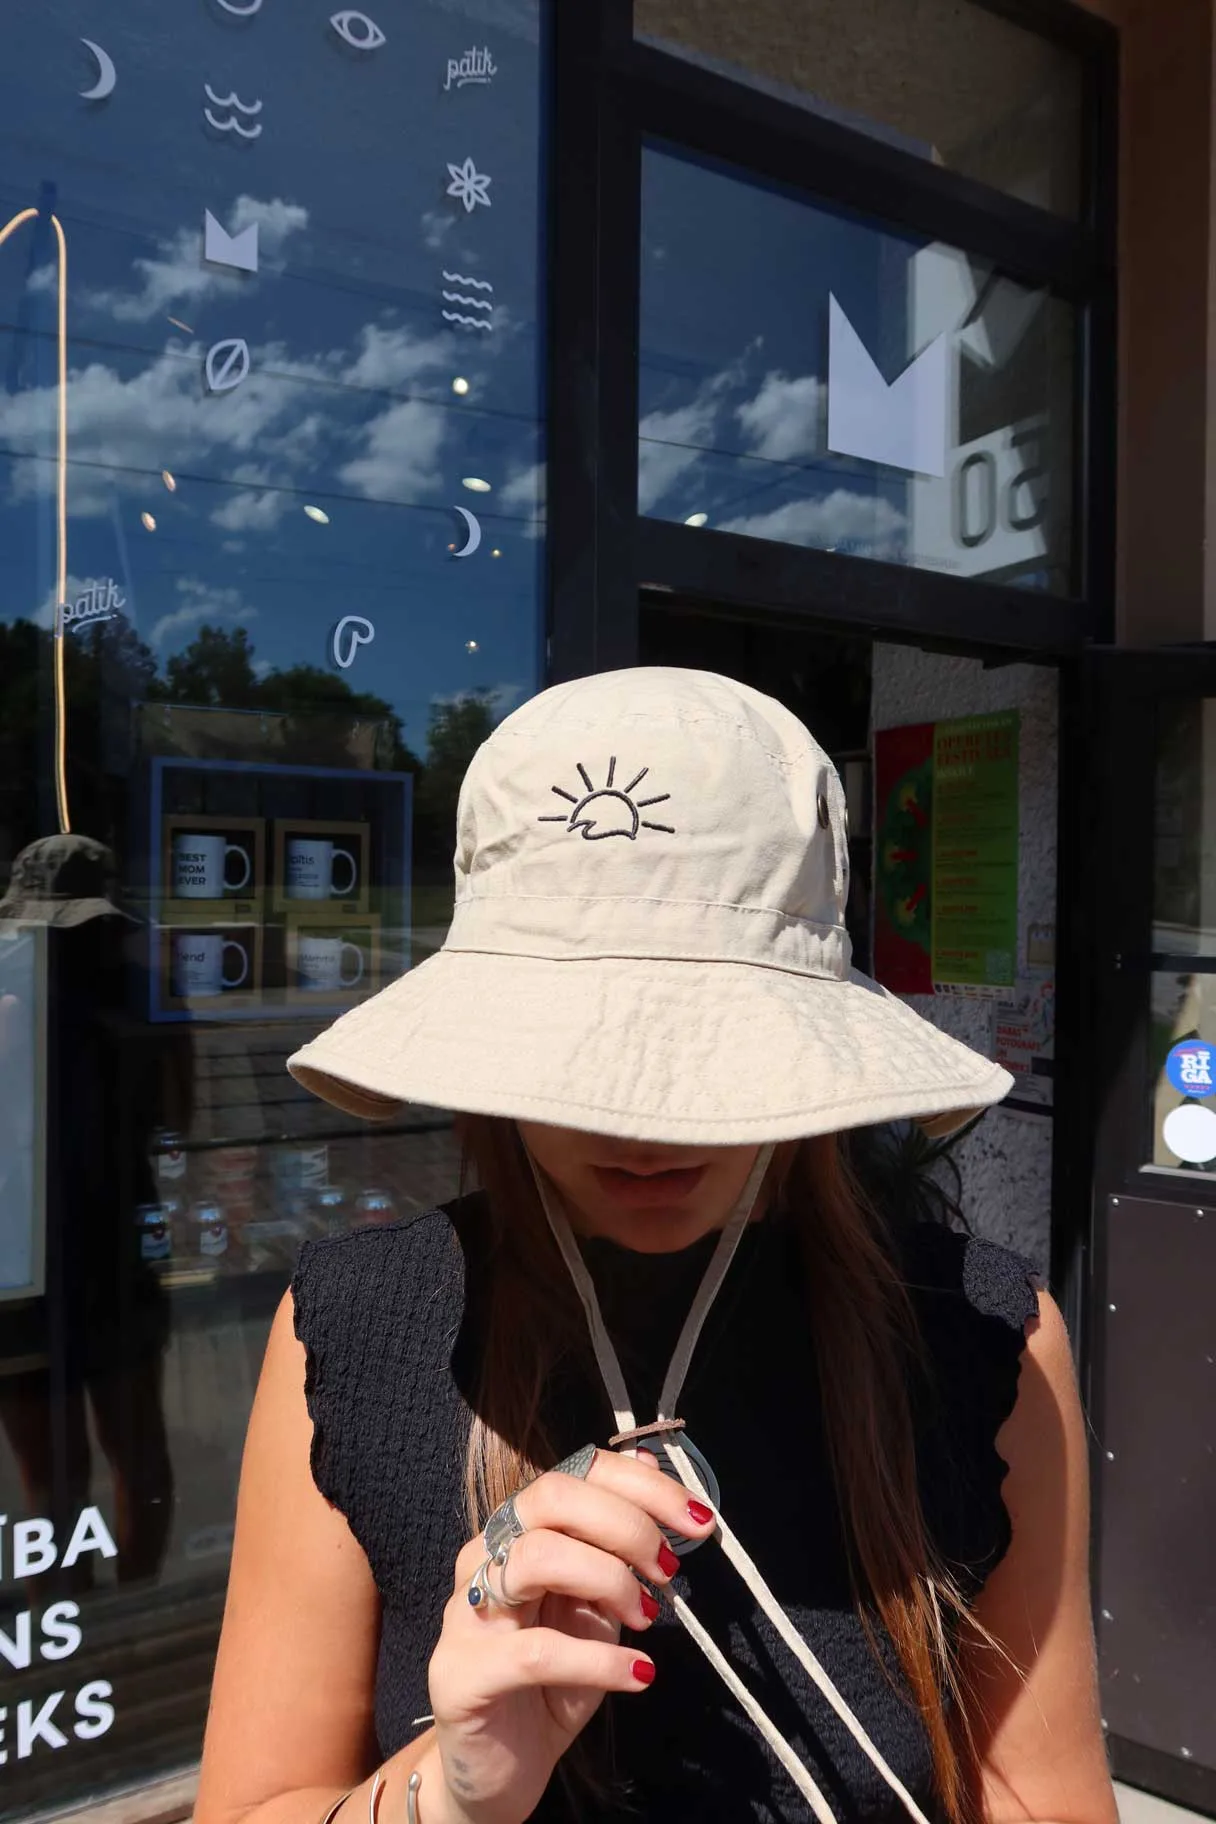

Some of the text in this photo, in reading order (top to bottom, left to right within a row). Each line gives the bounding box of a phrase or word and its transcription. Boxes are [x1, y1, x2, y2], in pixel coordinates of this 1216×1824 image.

[178, 853, 207, 862] BEST
[178, 865, 205, 874] MOM
[178, 876, 207, 885] EVER
[0, 1505, 118, 1579] BA
[0, 1679, 115, 1765] KS
